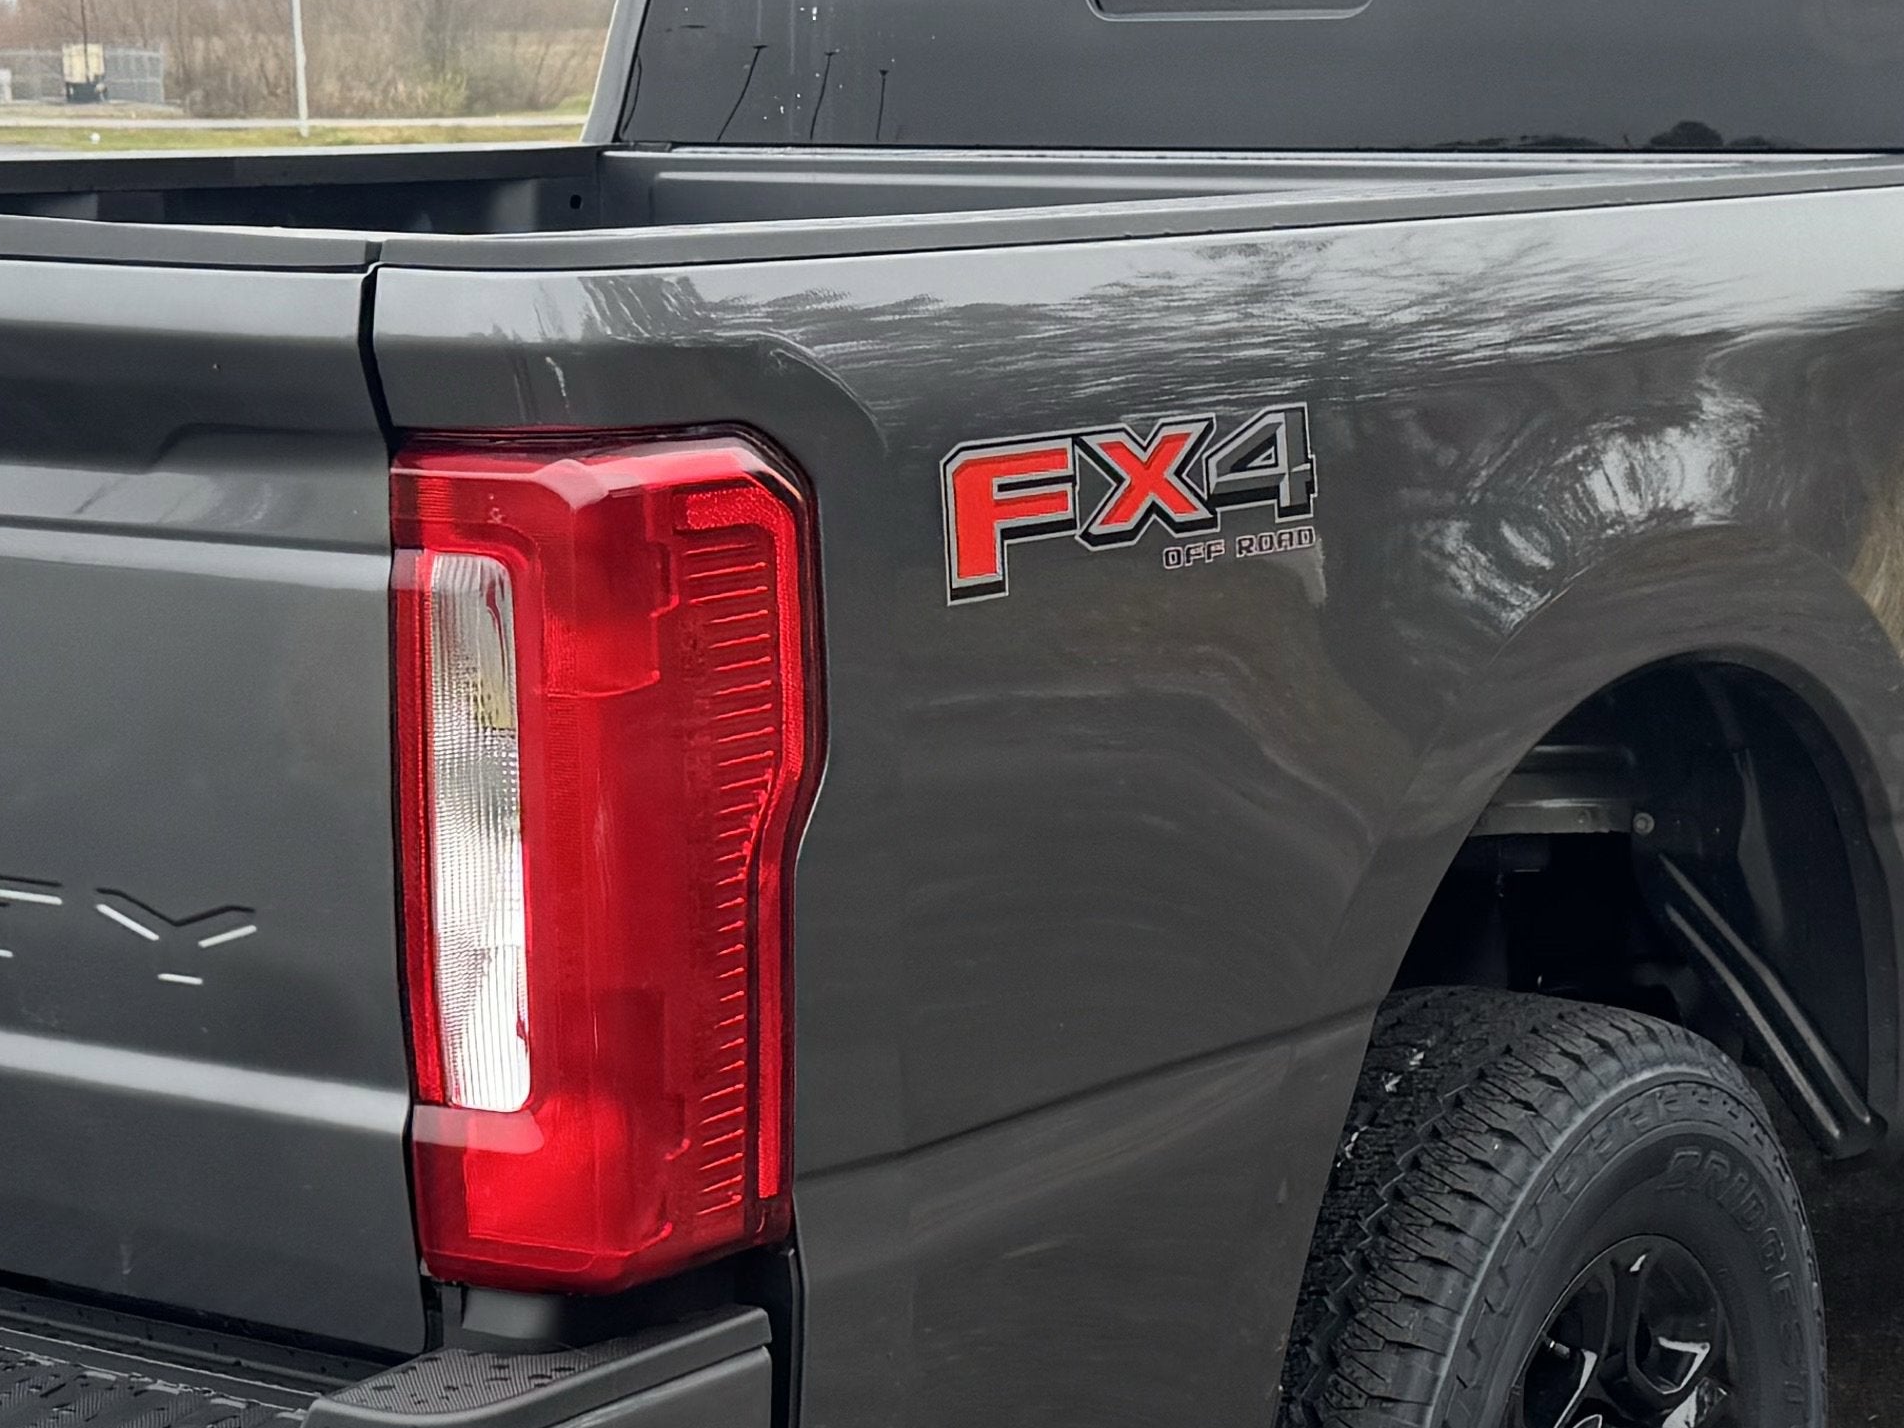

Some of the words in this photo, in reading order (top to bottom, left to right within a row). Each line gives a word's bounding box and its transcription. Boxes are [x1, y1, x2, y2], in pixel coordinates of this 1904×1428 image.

[940, 401, 1318, 606] FX4
[1162, 537, 1225, 570] OFF
[1236, 526, 1315, 558] ROAD
